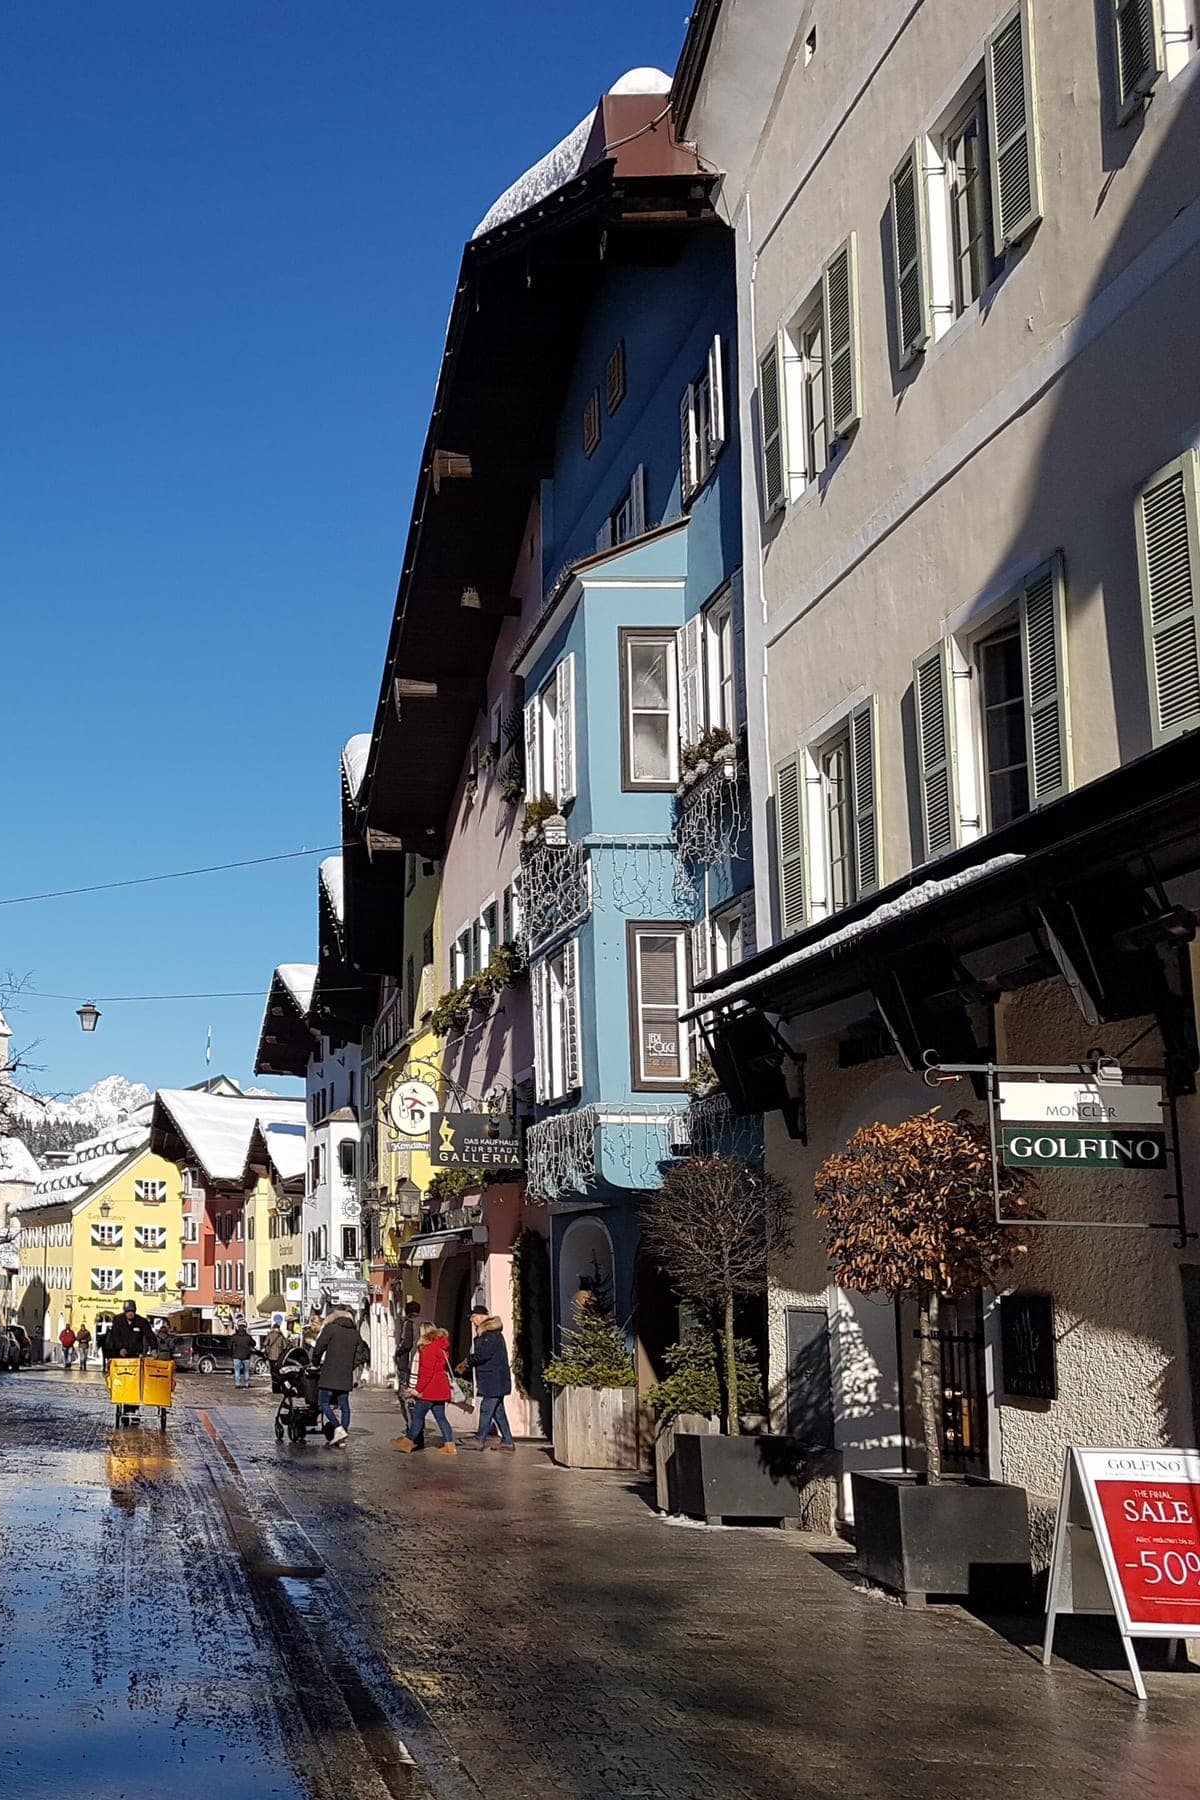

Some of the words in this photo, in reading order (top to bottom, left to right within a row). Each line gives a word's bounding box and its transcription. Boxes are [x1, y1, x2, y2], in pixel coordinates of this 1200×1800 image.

[1046, 1105, 1118, 1118] MONCLER
[480, 1138, 519, 1146] KAUFHAUS
[464, 1145, 484, 1153] ZUR
[487, 1146, 519, 1154] STADT
[1009, 1136, 1160, 1161] GOLFINO
[439, 1152, 520, 1164] GALLERIA
[1107, 1459, 1181, 1472] GOLFINO
[1133, 1489, 1150, 1498] THE
[1150, 1490, 1173, 1499] FINAL
[1123, 1499, 1193, 1524] SALE
